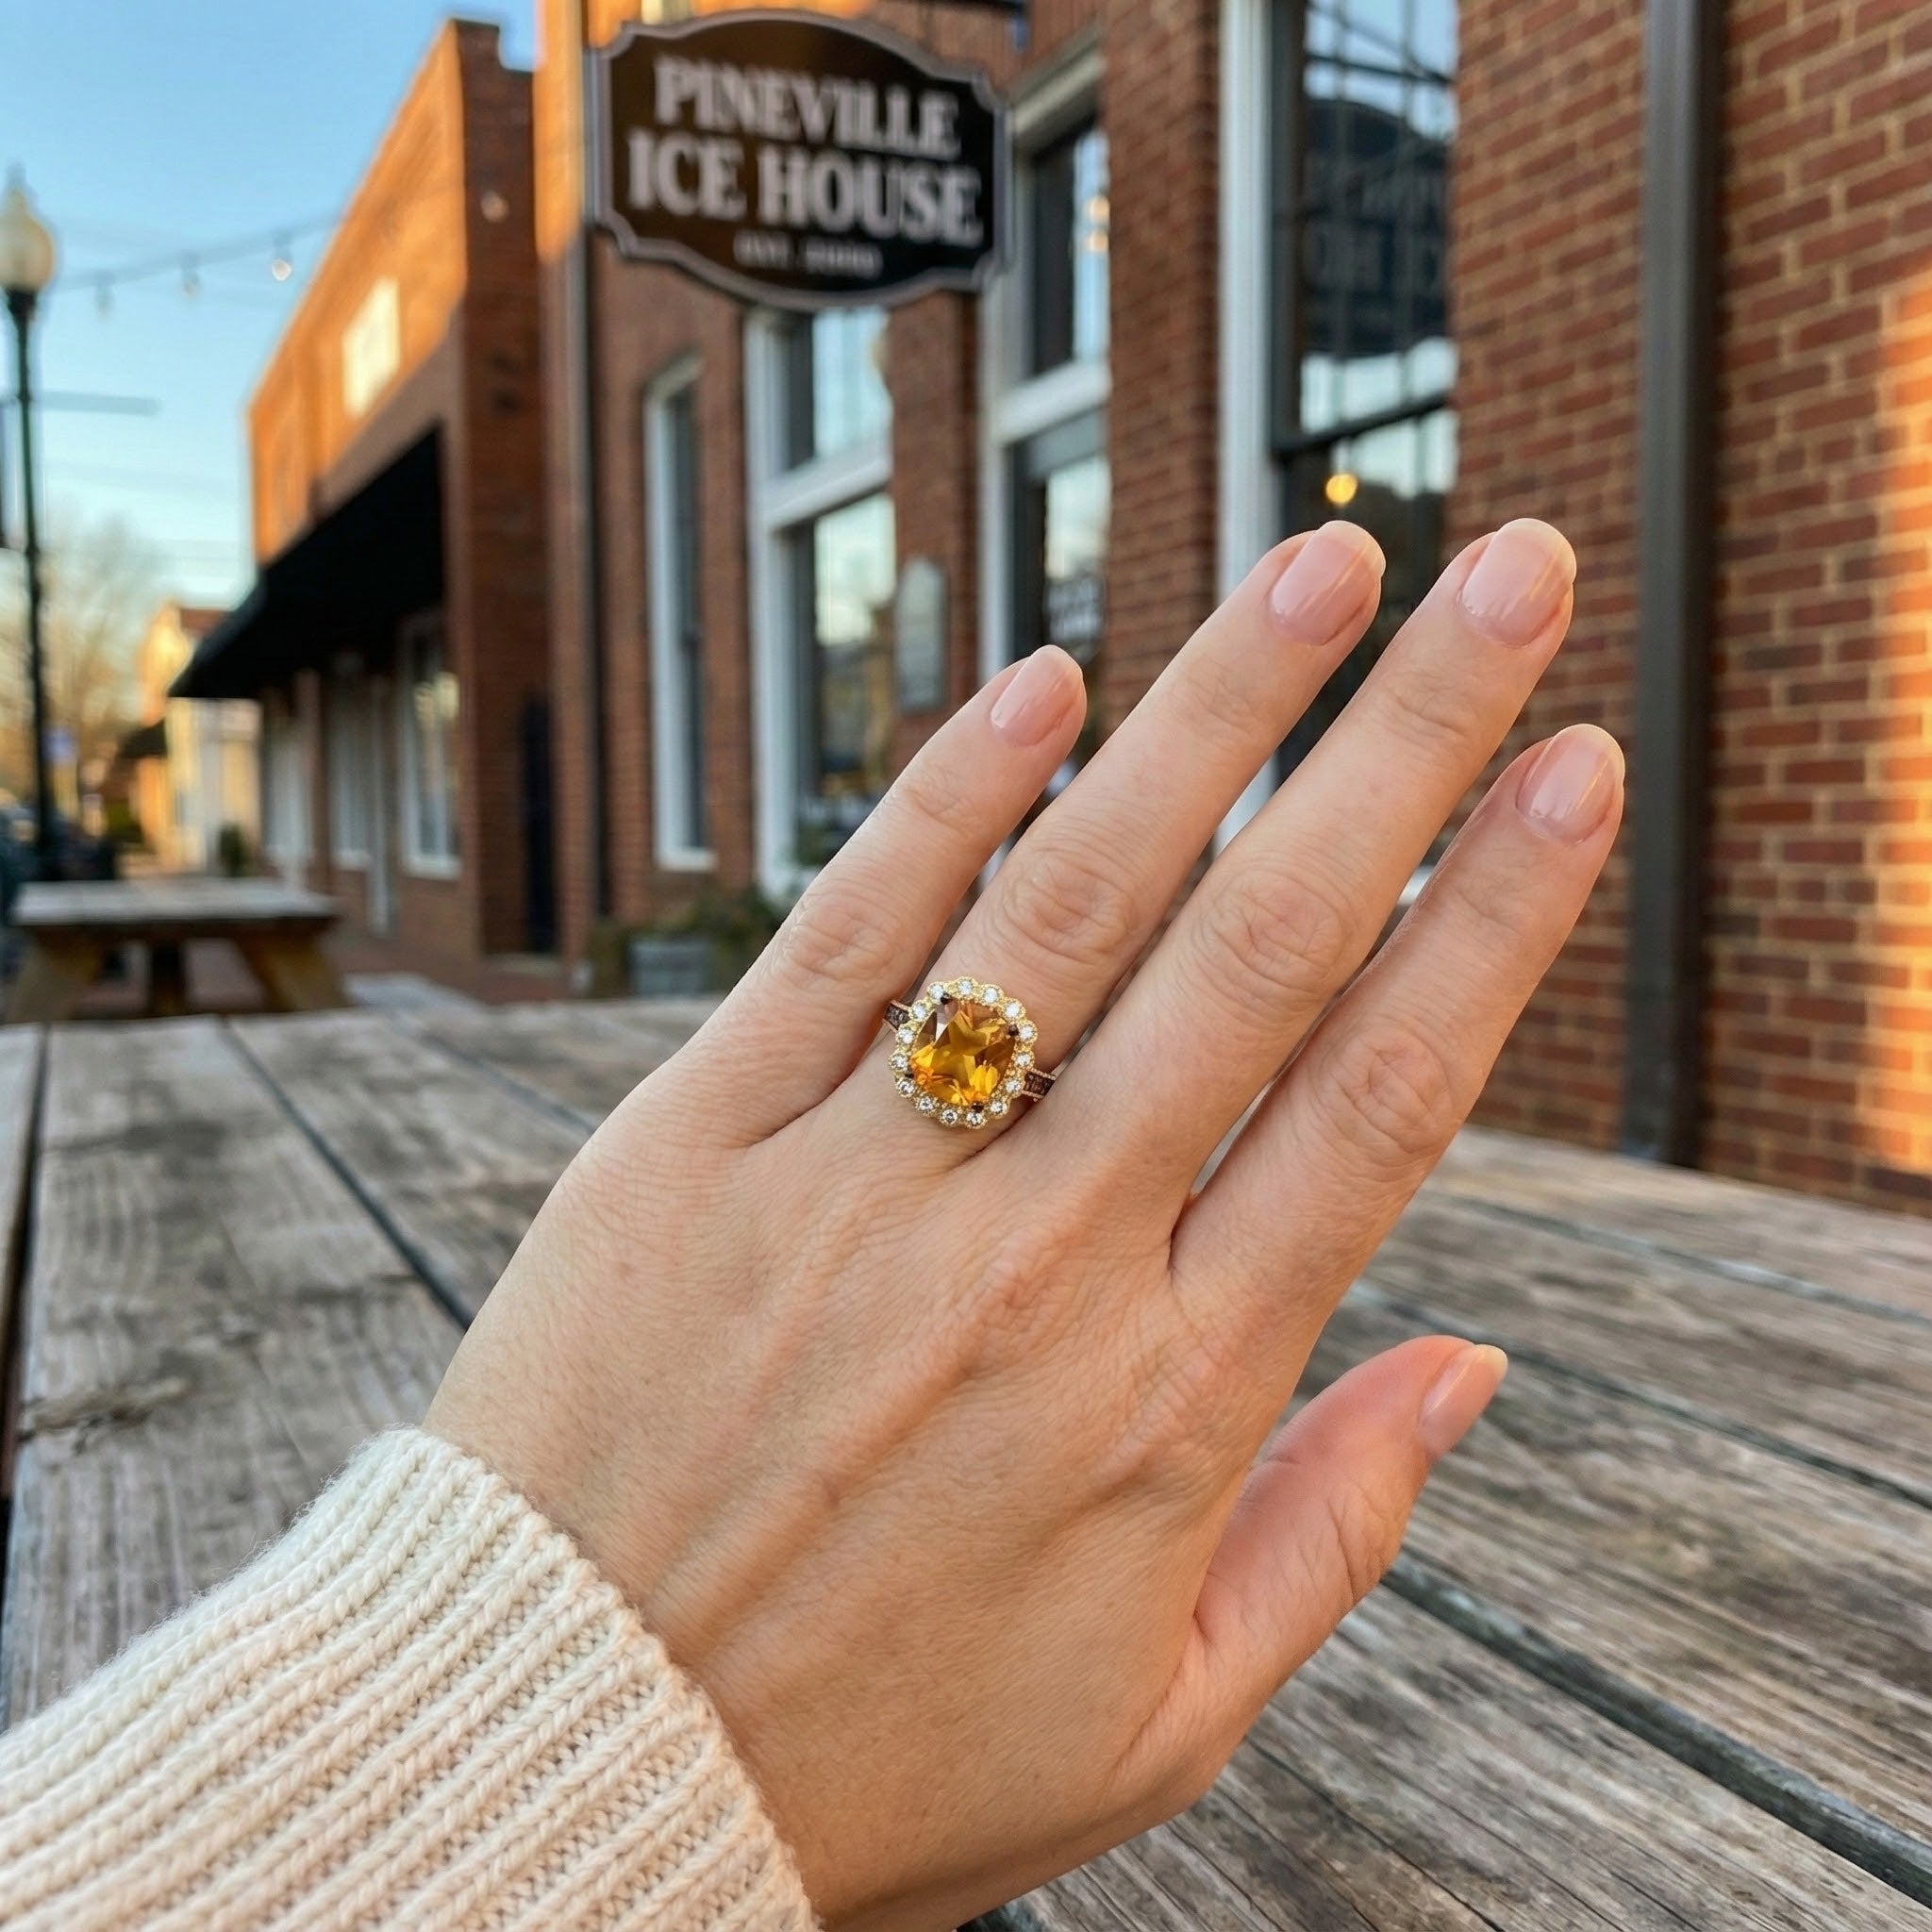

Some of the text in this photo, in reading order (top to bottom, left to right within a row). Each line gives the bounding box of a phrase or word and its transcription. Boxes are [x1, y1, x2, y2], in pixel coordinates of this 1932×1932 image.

[656, 57, 959, 158] PINEVILLE
[629, 130, 982, 246] ICE HOUSE
